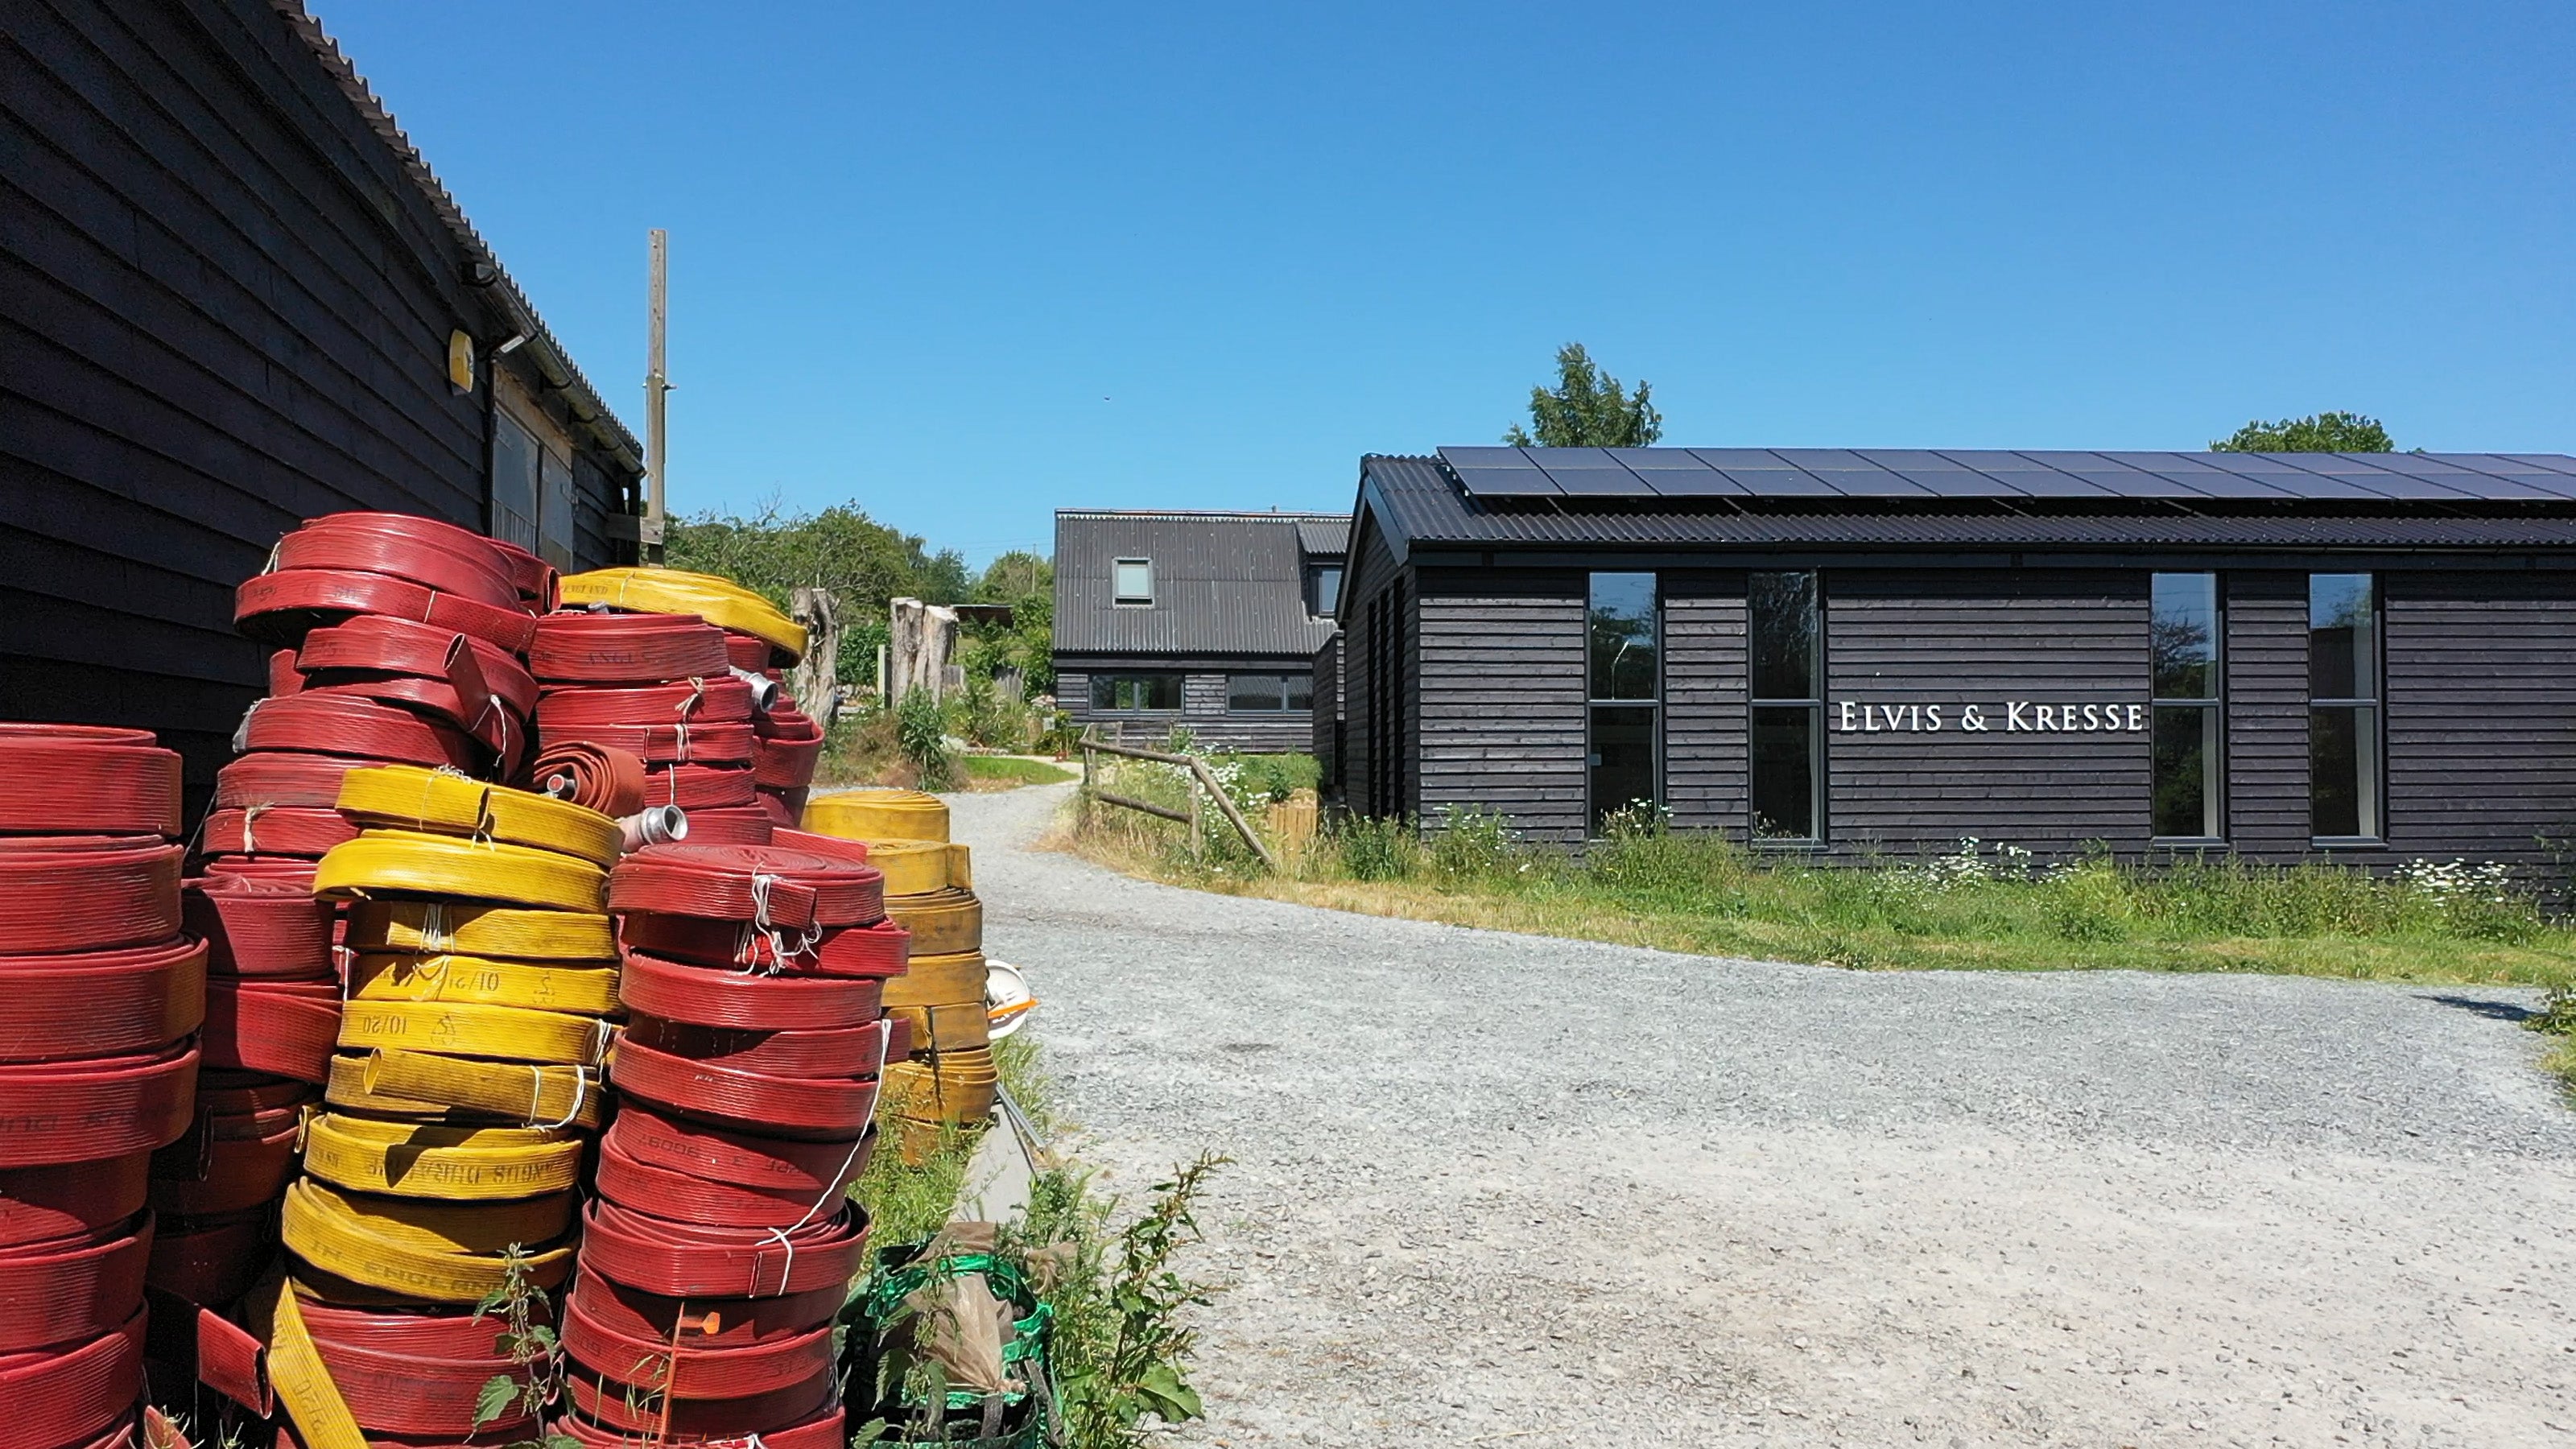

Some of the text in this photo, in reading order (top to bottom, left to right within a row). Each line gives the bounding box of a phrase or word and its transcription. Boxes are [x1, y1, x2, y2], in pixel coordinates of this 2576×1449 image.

[1839, 701, 2143, 731] ELVIS & KRESSE
[362, 1015, 407, 1035] 10/20
